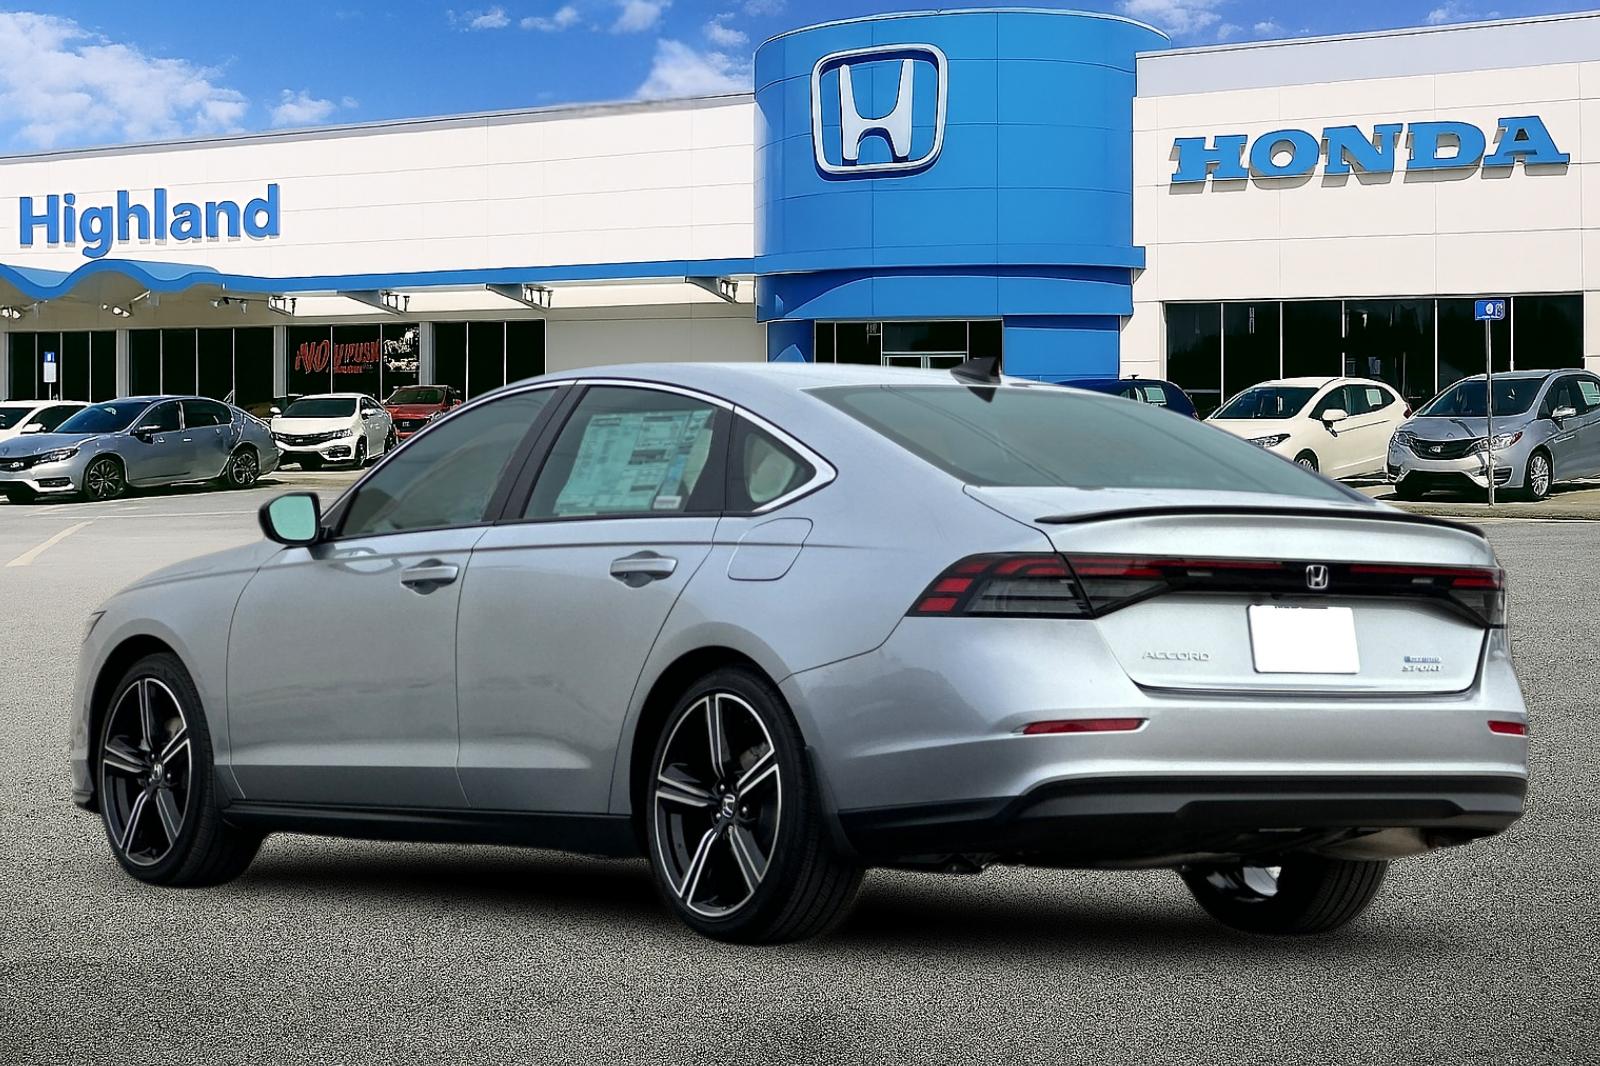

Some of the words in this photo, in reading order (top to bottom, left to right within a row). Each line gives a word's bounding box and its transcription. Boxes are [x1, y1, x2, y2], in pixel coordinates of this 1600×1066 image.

[1169, 115, 1571, 186] HONDA
[19, 183, 281, 259] Highland
[1141, 650, 1210, 662] ACCORD
